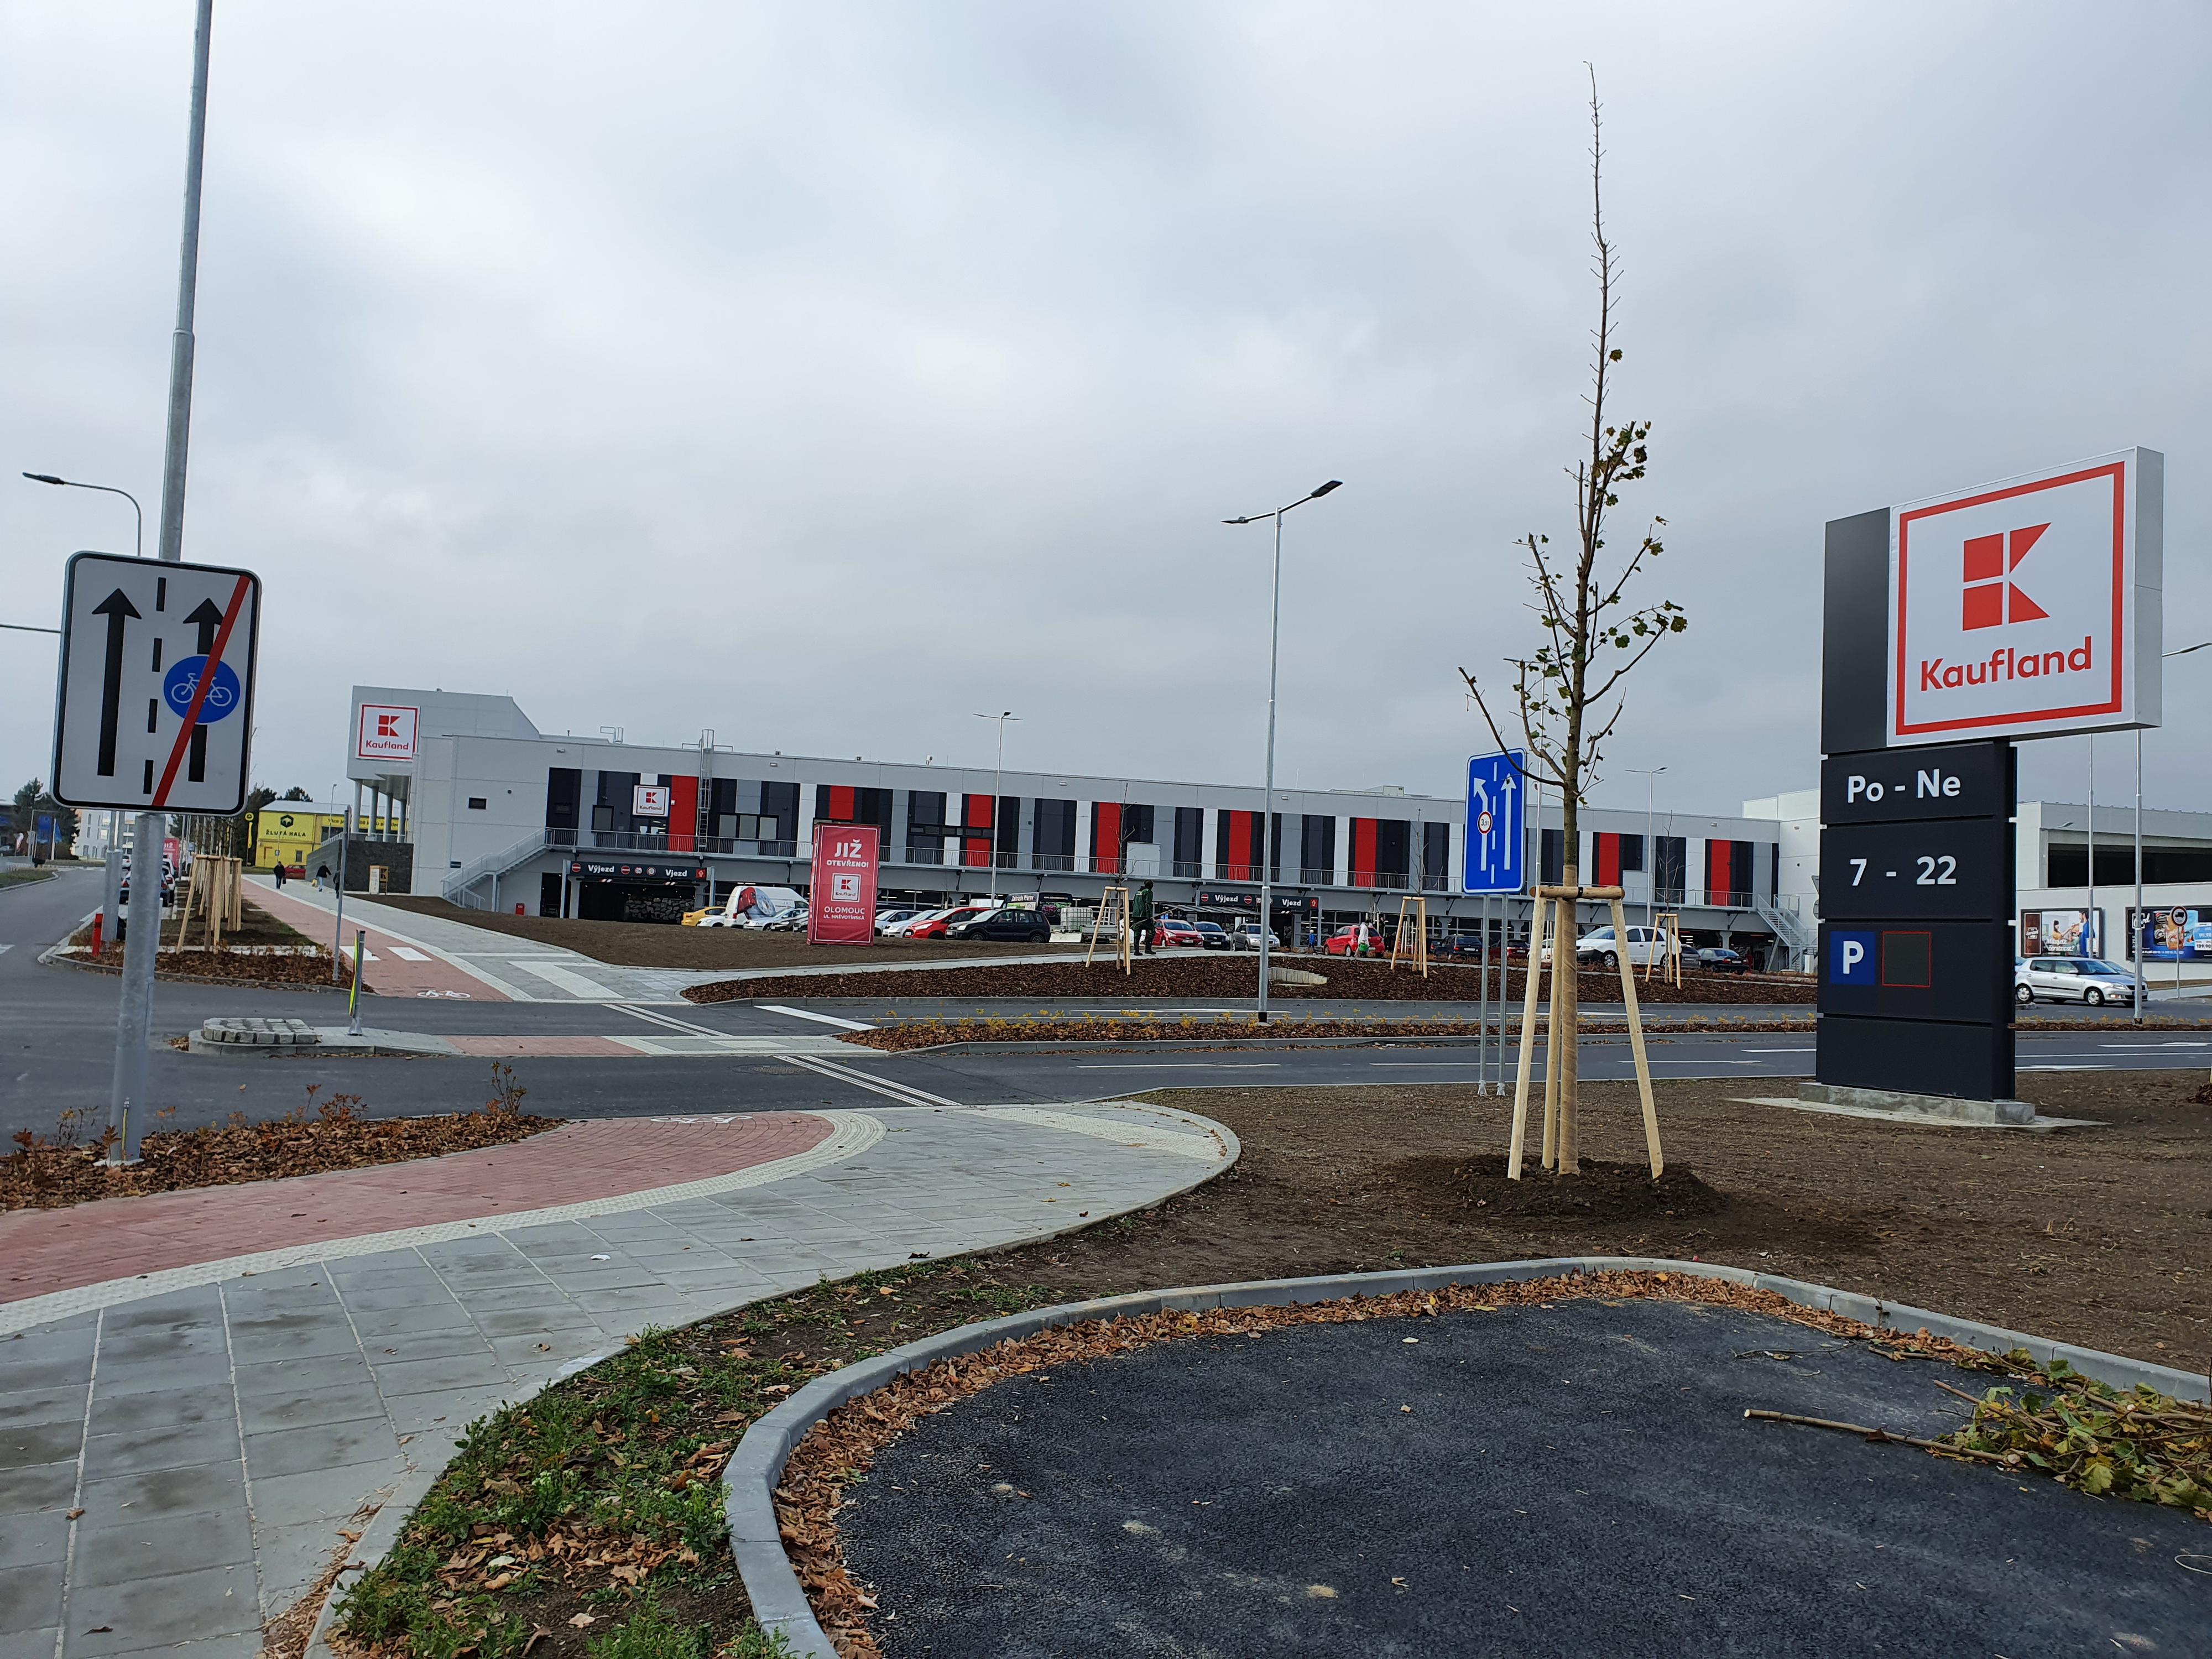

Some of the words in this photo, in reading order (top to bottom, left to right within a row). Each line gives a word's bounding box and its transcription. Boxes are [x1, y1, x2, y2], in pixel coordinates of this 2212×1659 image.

[1921, 635, 2092, 692] Kaufland
[366, 740, 409, 750] Kaufland
[1847, 775, 1884, 804] Po
[1917, 769, 1961, 799] Ne
[834, 838, 862, 858] JIŽ
[826, 859, 869, 868] OTEVŘENO!
[588, 864, 614, 873] Výjezd
[1849, 858, 1867, 887] 7
[1916, 855, 1957, 886] 22
[665, 869, 687, 878] Vjezd
[1214, 894, 1238, 903] Výjezd
[1282, 899, 1302, 907] Vjezd
[824, 906, 865, 915] OLOMOUC
[1842, 940, 1864, 974] P
